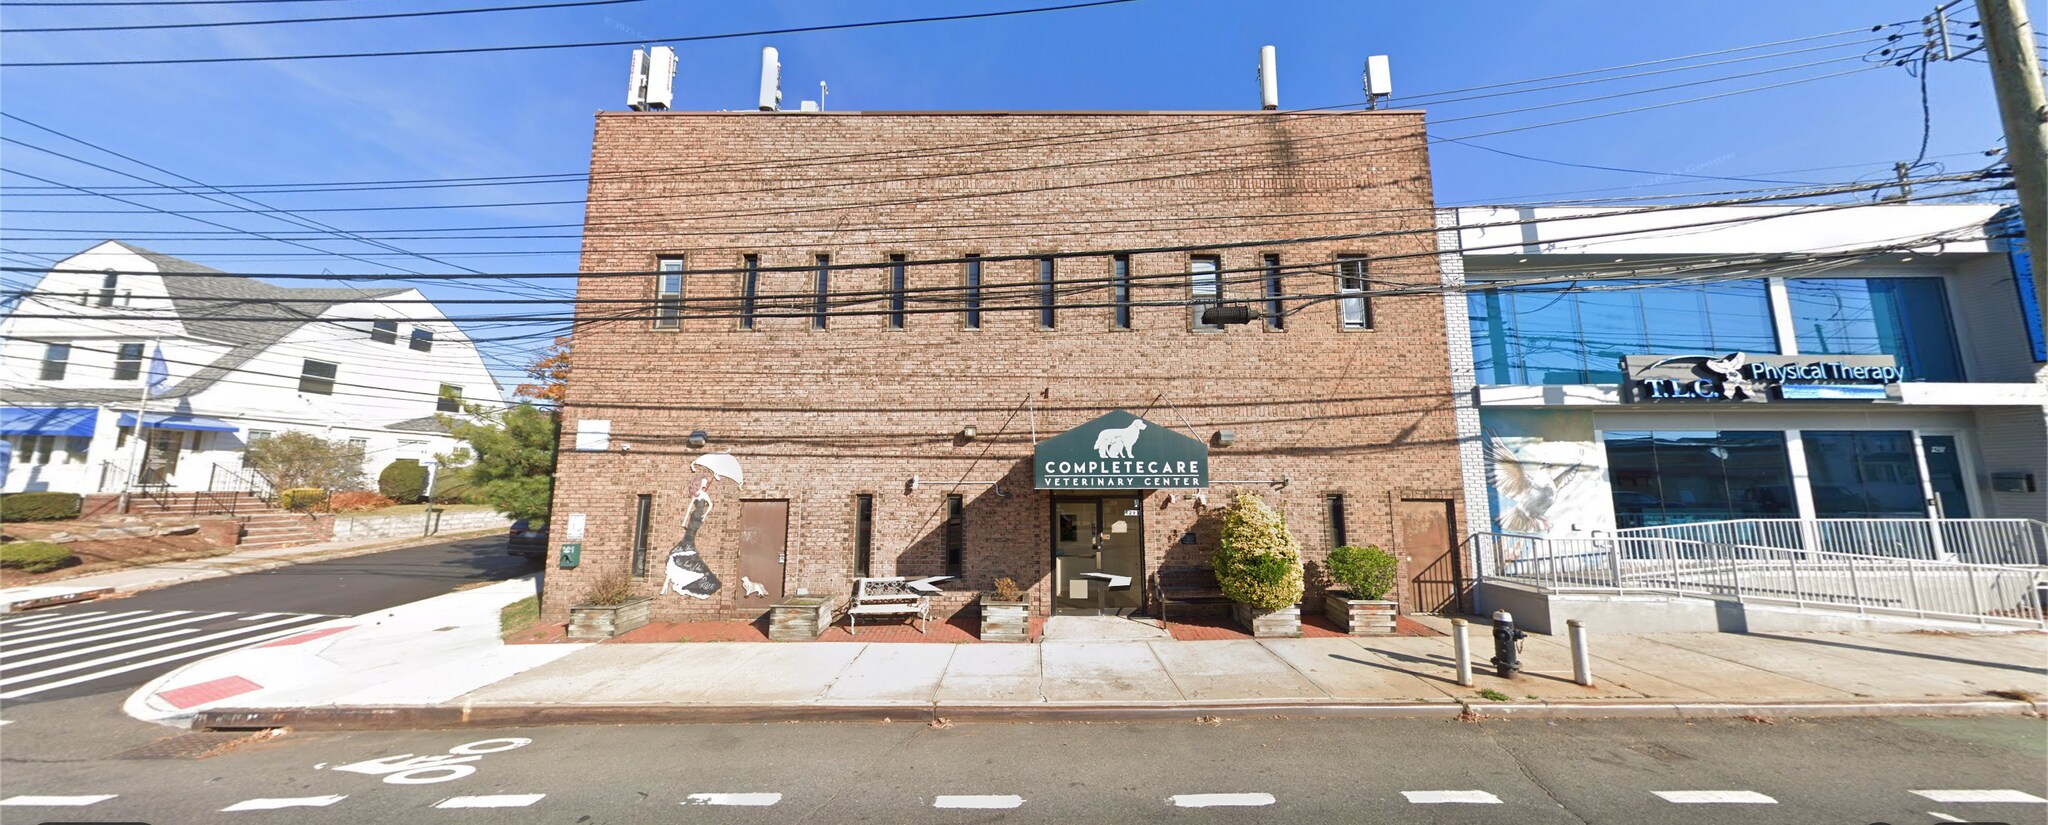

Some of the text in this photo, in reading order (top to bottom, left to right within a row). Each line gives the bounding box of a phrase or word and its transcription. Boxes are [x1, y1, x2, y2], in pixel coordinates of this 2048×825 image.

[1751, 362, 1904, 384] Physical Therapy
[1644, 377, 1719, 398] T.L.C.
[1045, 461, 1199, 474] COMPLETECARE
[1044, 477, 1200, 486] VETERINARY CENTER
